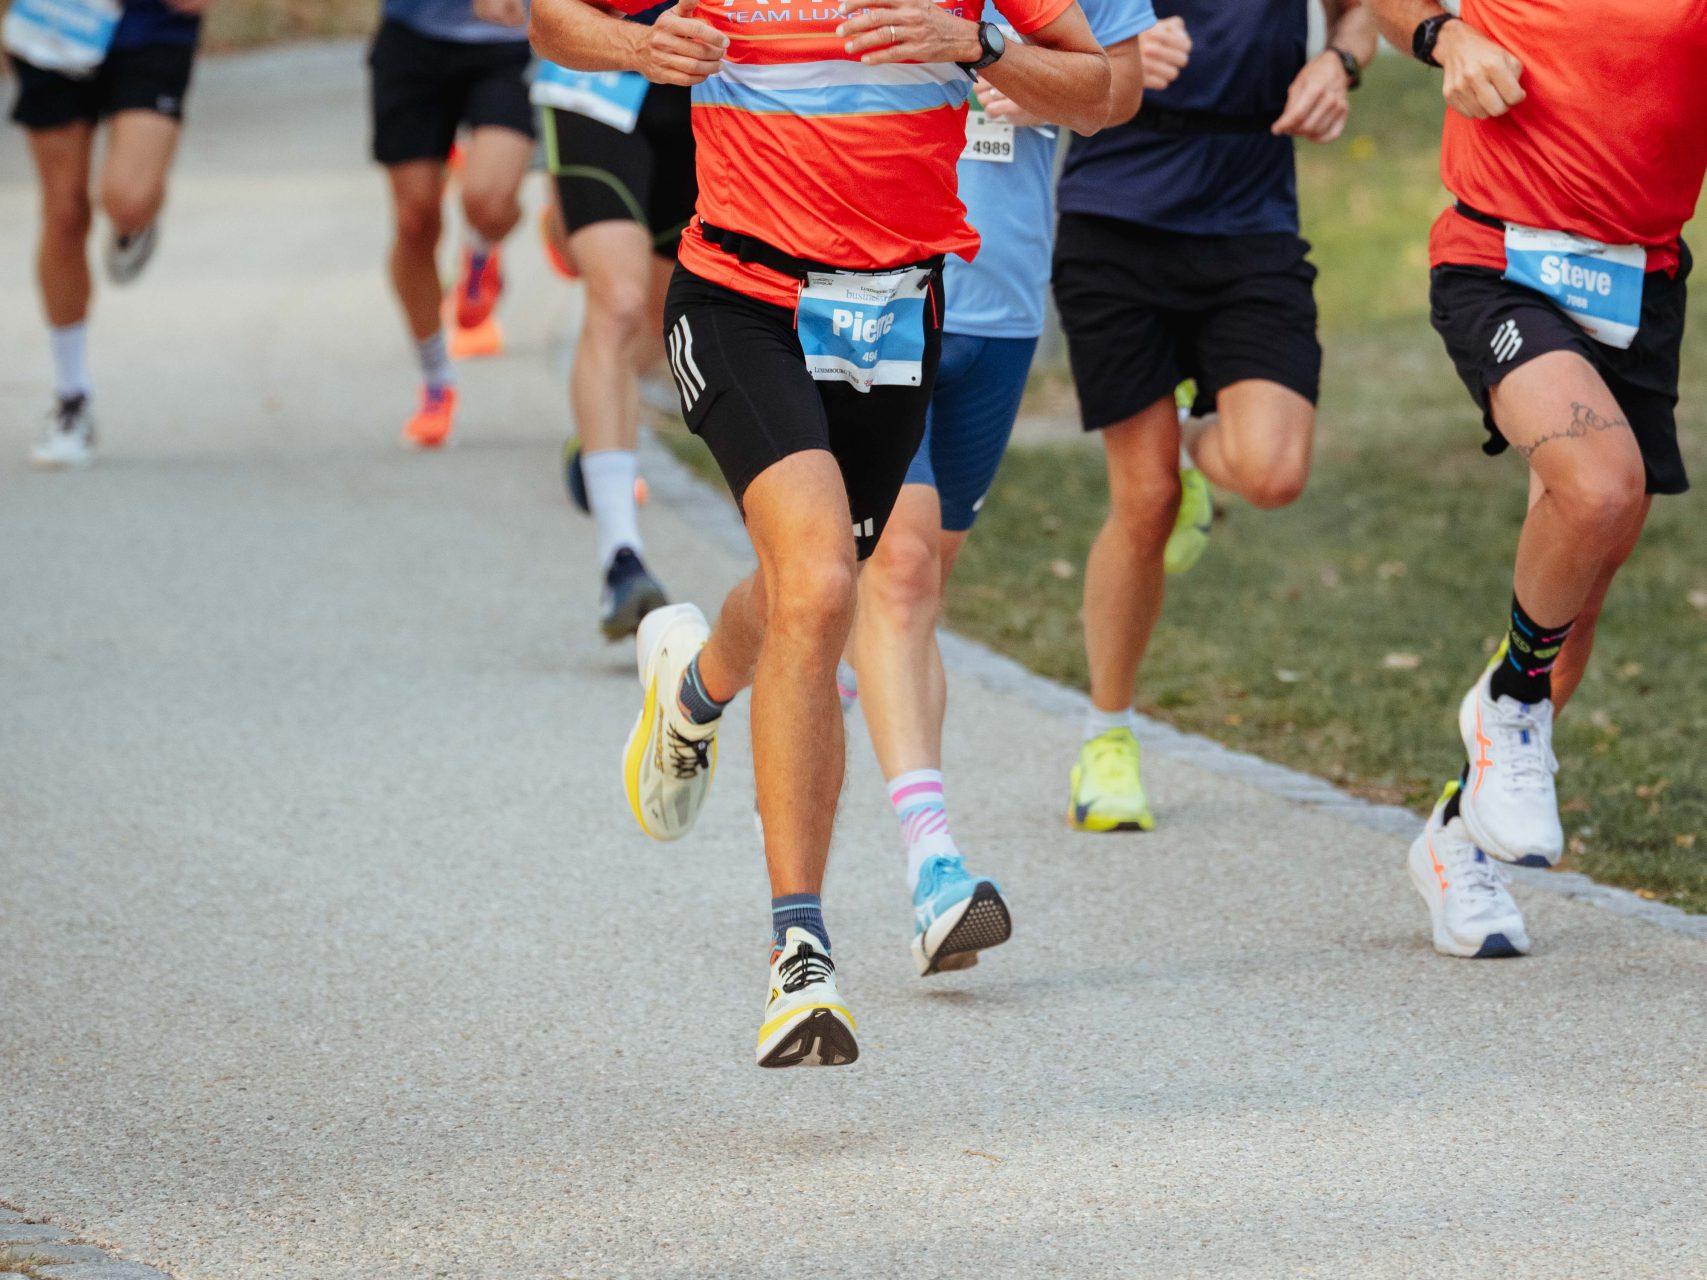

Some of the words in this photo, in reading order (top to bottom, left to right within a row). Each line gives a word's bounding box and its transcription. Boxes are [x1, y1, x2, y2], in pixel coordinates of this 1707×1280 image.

[723, 9, 790, 24] TEAM
[972, 140, 1011, 156] 4989
[1540, 255, 1612, 296] Steve
[832, 308, 895, 344] Pierre
